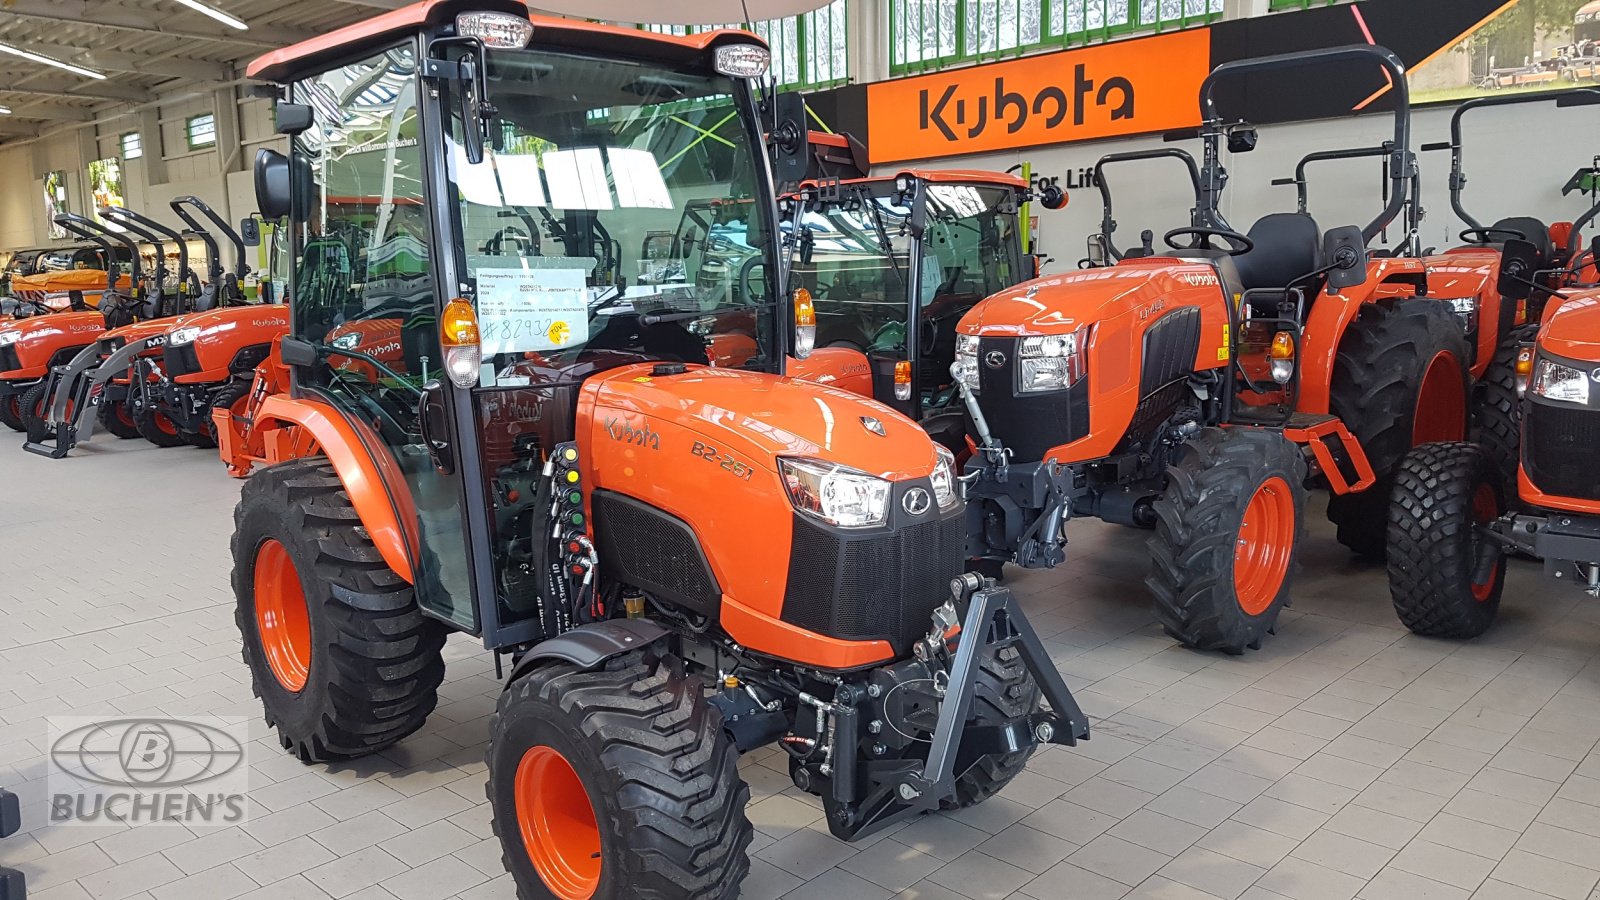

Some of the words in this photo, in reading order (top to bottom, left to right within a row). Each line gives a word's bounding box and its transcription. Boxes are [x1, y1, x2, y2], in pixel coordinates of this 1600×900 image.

[919, 63, 1135, 142] Kubota
[1030, 172, 1059, 192] For
[1183, 272, 1219, 286] Kubota
[252, 317, 286, 327] Kubota
[363, 341, 401, 357] Kubota
[603, 414, 660, 451] Kubota
[690, 440, 754, 483] B2-261
[552, 563, 560, 574] ID
